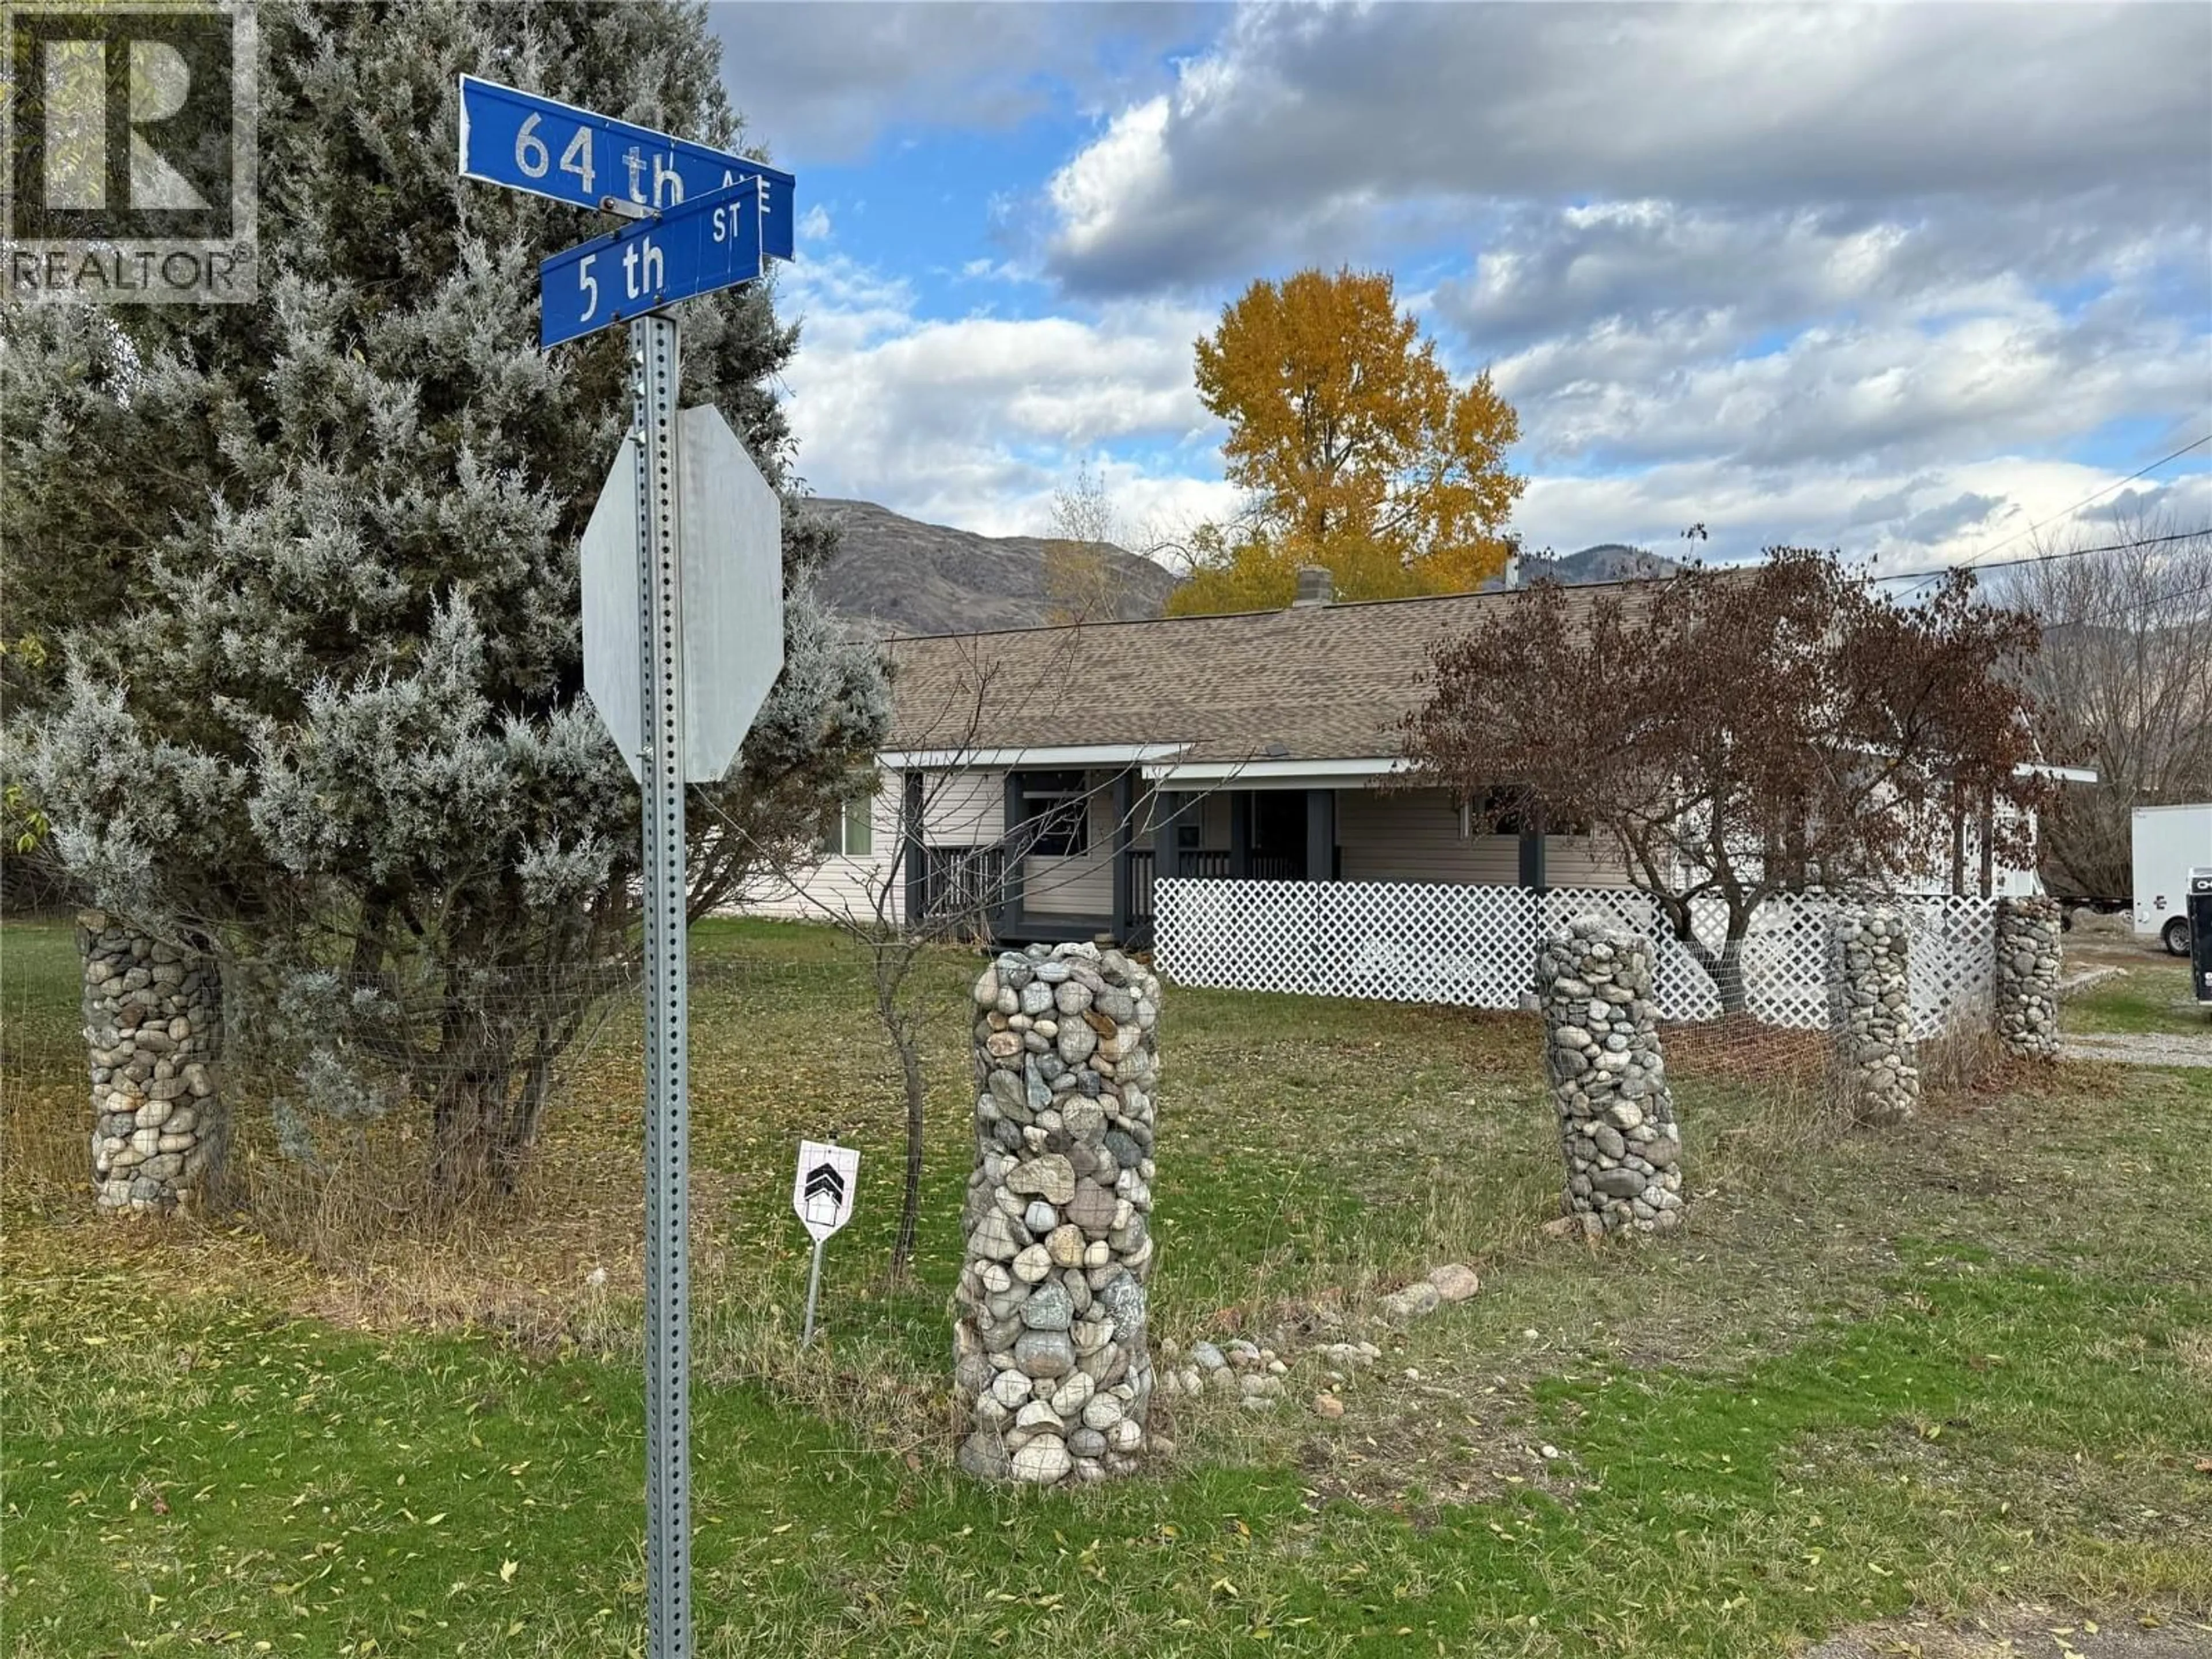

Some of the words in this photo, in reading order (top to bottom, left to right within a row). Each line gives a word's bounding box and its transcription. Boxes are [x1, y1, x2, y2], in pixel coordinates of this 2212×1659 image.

[516, 112, 596, 194] 64
[622, 146, 684, 209] th
[723, 170, 771, 213] AE
[580, 253, 597, 322] 5
[623, 236, 664, 300] th
[713, 202, 741, 242] ST
